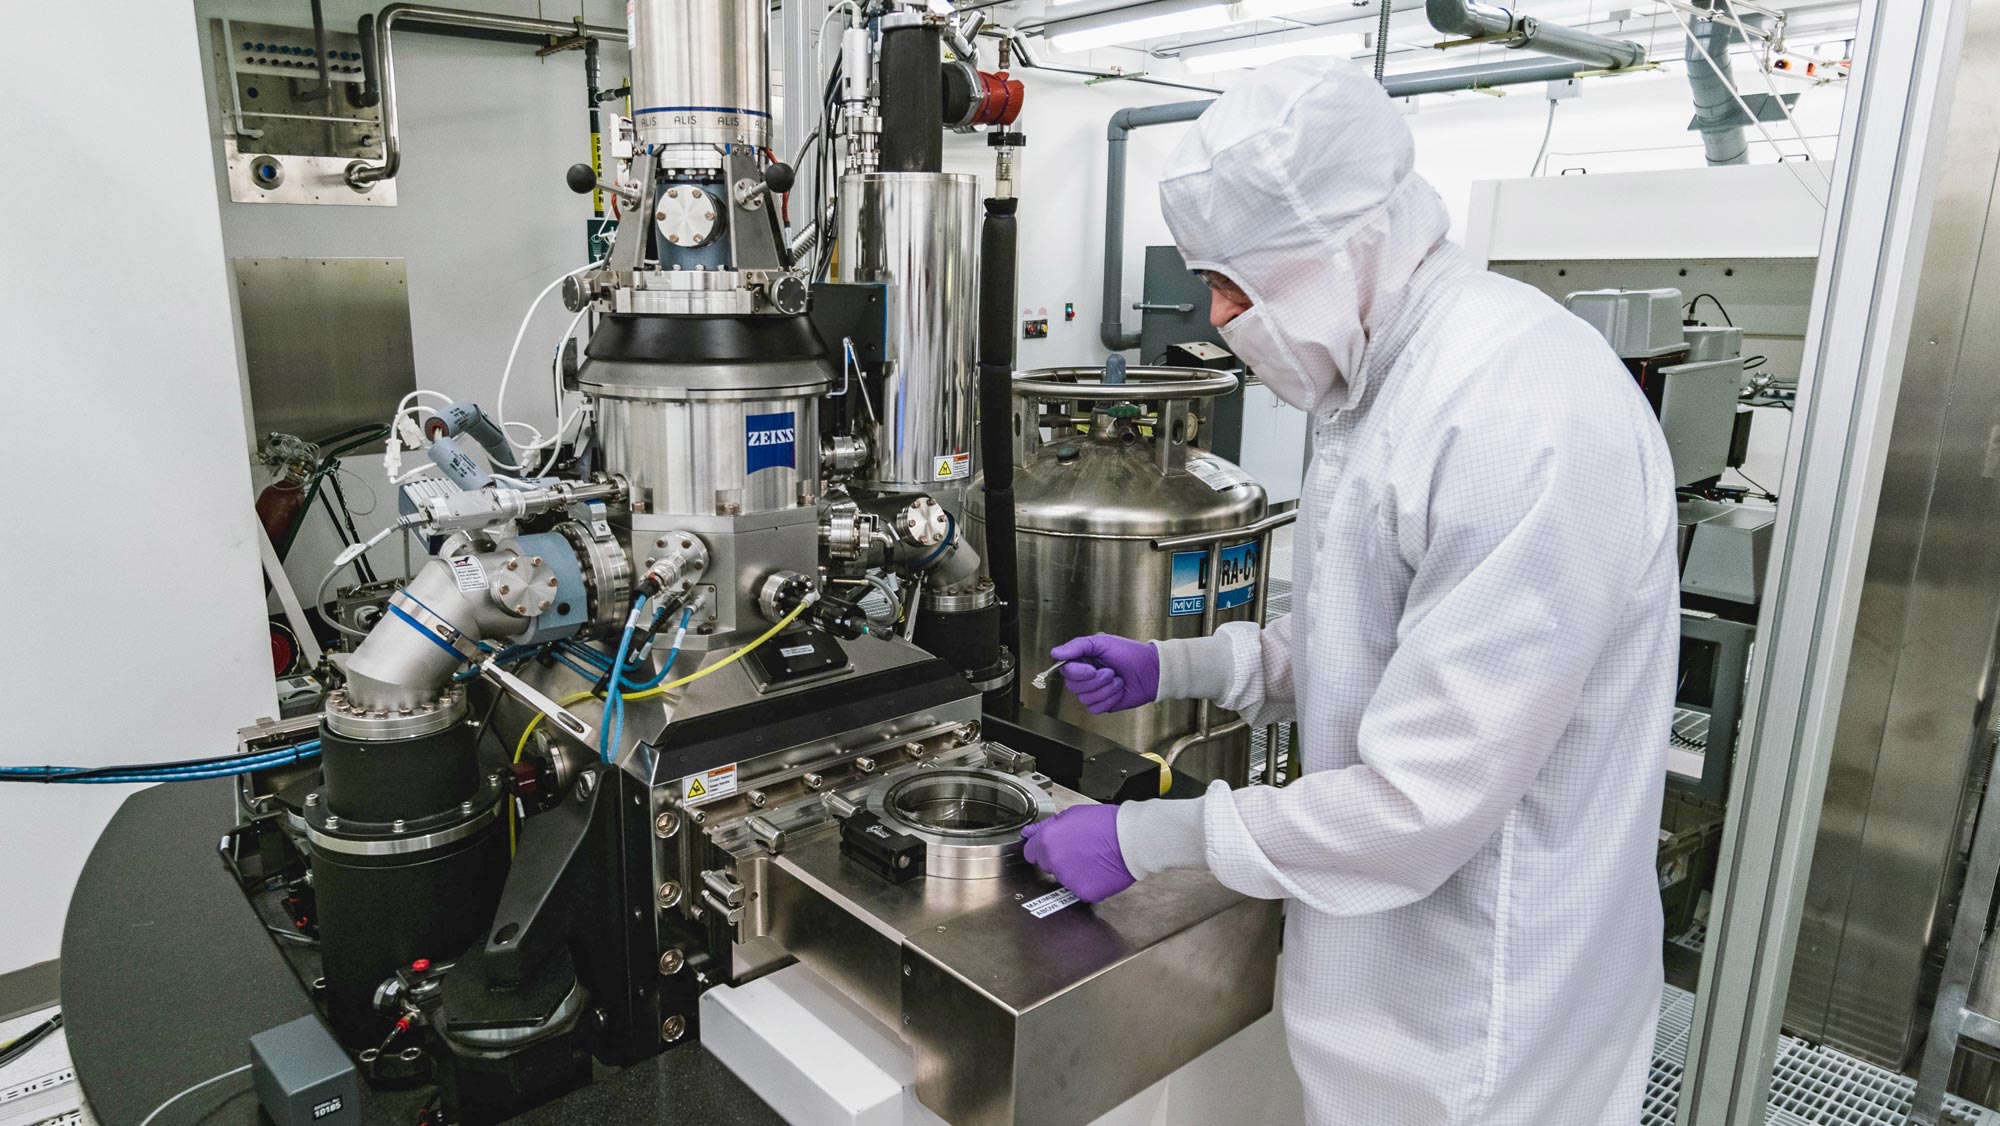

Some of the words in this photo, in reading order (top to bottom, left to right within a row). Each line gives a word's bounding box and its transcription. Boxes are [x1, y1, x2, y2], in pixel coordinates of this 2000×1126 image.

[641, 116, 657, 127] ALIS
[674, 115, 697, 125] ALIS
[717, 116, 740, 127] ALIS
[596, 137, 605, 204] SPEAKAN
[748, 428, 794, 446] ZEISS
[1198, 548, 1259, 590] DRA-CY
[1173, 600, 1203, 611] MVE
[1026, 892, 1060, 909] MAXIMUM
[1036, 903, 1060, 916] ABOVE
[314, 1101, 342, 1118] 10185
